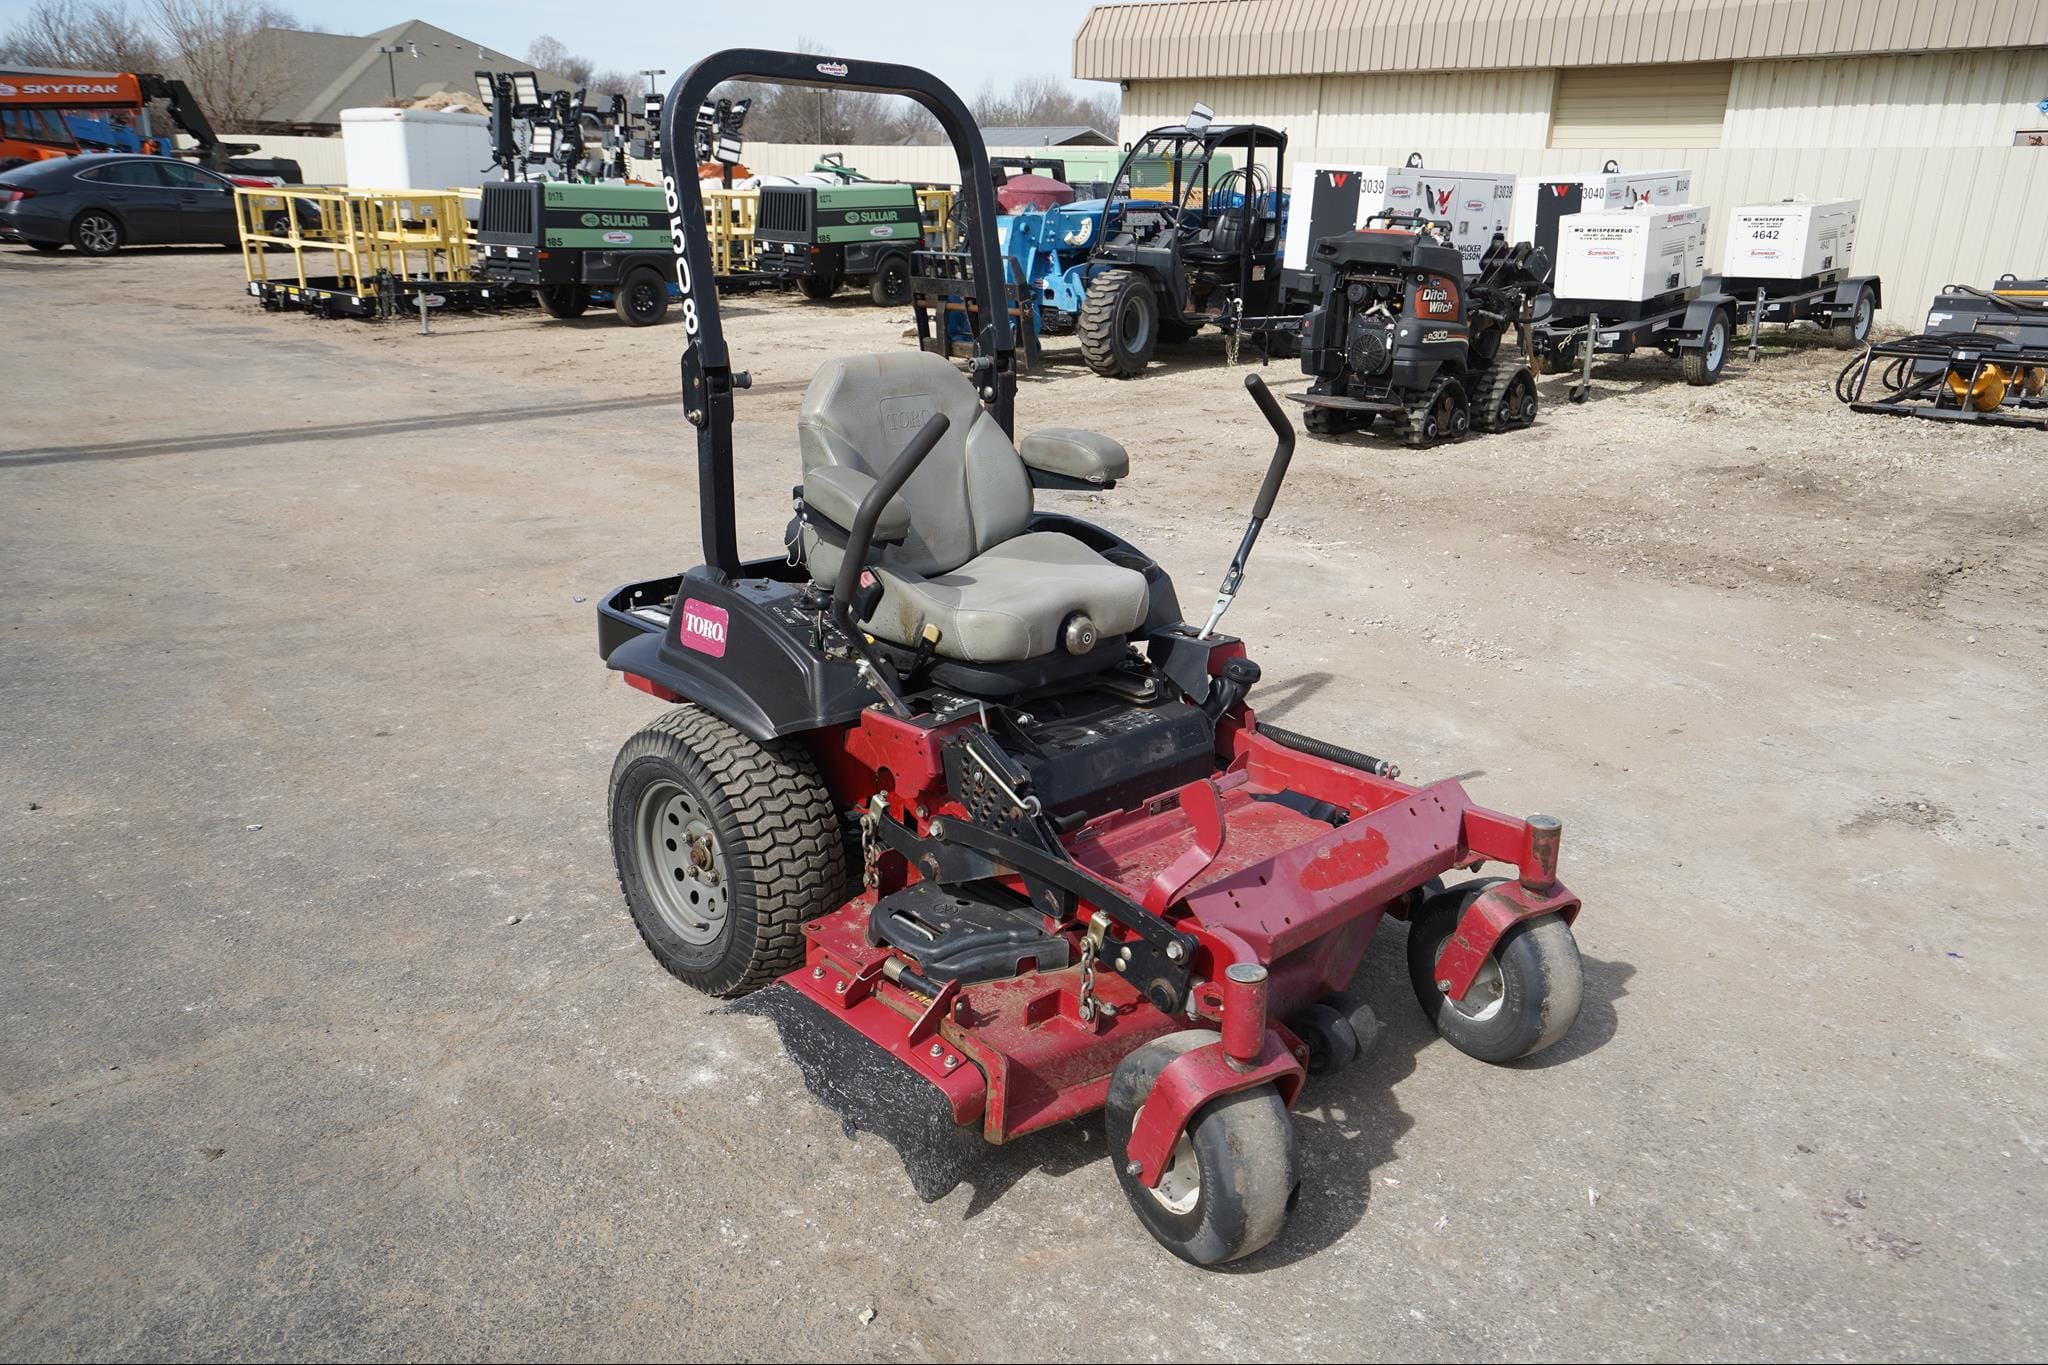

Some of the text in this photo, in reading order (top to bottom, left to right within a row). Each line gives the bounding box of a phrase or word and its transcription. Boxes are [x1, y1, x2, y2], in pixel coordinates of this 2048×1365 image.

[22, 84, 119, 94] SKYTRAK
[1360, 179, 1385, 194] 3039
[1582, 187, 1605, 200] 3040
[600, 215, 649, 227] SULLAIR
[860, 210, 898, 222] SULLAIR
[819, 235, 831, 243] 185
[1752, 230, 1780, 240] 4642
[547, 238, 564, 247] 185
[1458, 244, 1482, 253] WACKER
[663, 175, 698, 334] 8508
[1461, 253, 1480, 261] EUSON
[1422, 288, 1448, 301] Ditch
[1429, 301, 1453, 313] Witch
[685, 613, 724, 642] TORO
